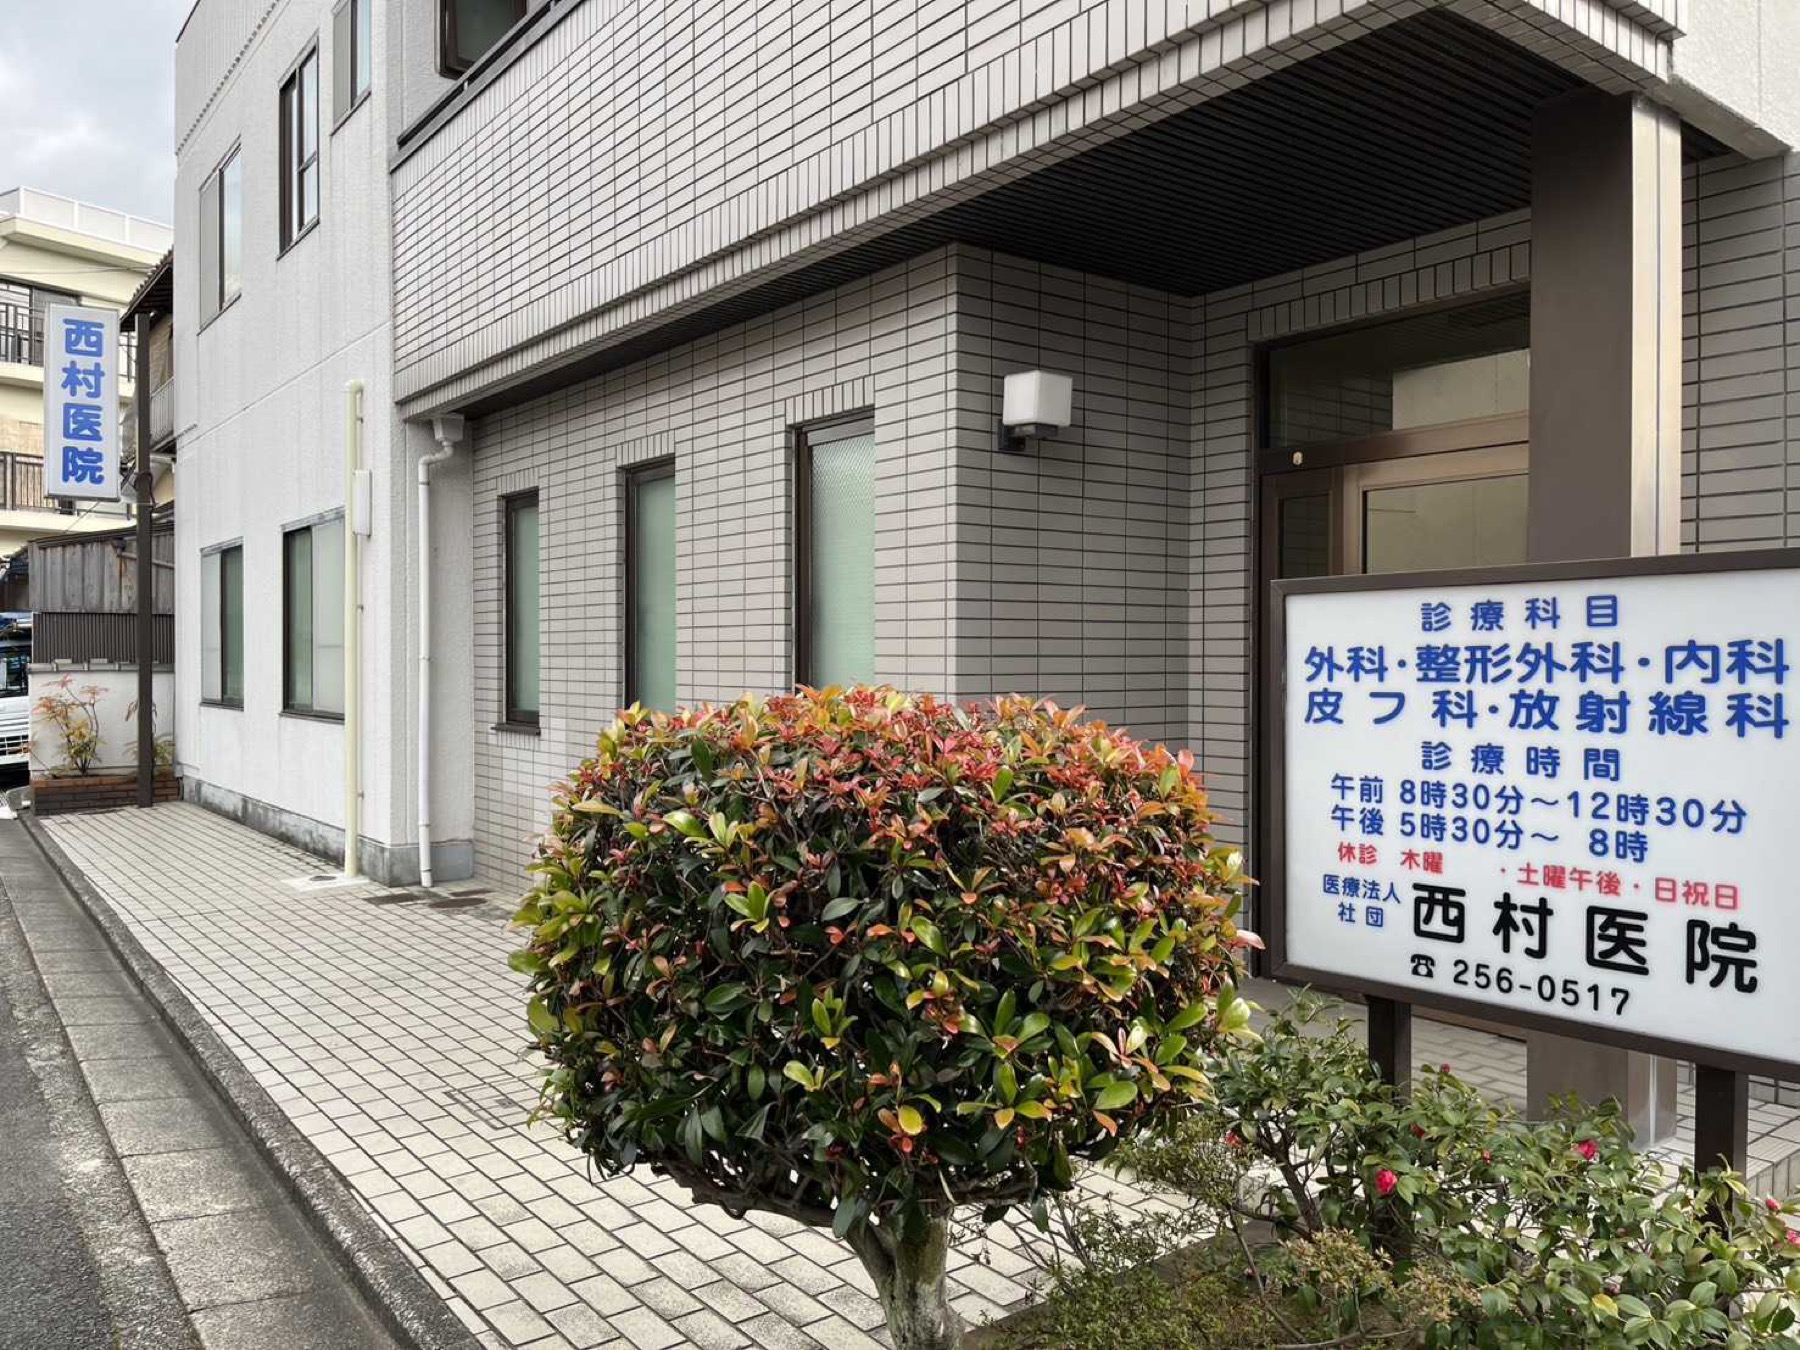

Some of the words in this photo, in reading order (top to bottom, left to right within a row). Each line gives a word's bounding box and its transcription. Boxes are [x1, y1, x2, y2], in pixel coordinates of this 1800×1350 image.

[61, 318, 105, 485] 西村医院
[1420, 595, 1619, 632] 診療科目
[1420, 741, 1621, 782] 診療時間
[1322, 873, 1401, 904] 医療法人
[1337, 901, 1384, 928] 社団
[1412, 882, 1758, 994] 西村医院
[1453, 959, 1631, 1016] 256-0517
